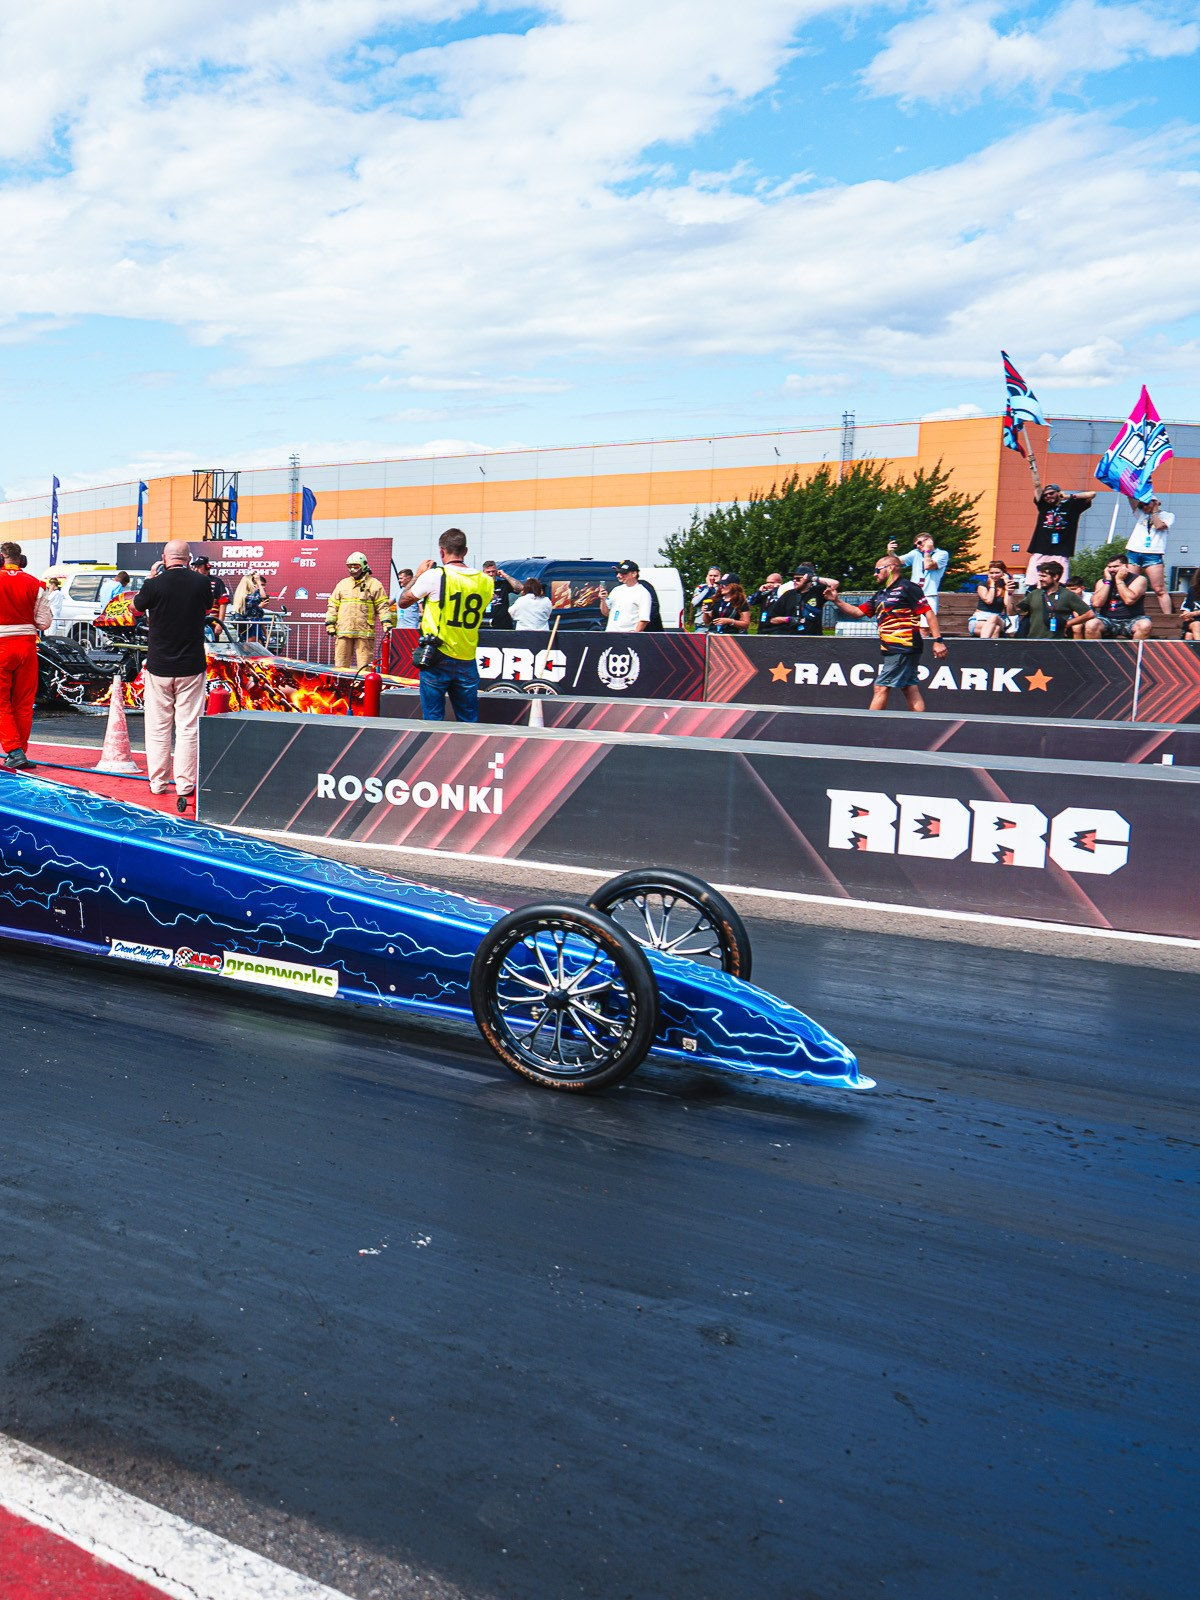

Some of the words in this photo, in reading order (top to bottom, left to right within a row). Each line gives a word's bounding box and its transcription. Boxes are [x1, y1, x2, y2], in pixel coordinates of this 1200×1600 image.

[300, 558, 316, 567] ВТБ
[447, 592, 483, 630] 18
[476, 646, 567, 682] DRC
[317, 773, 504, 815] ROSGONKI
[826, 788, 1131, 875] RDRC
